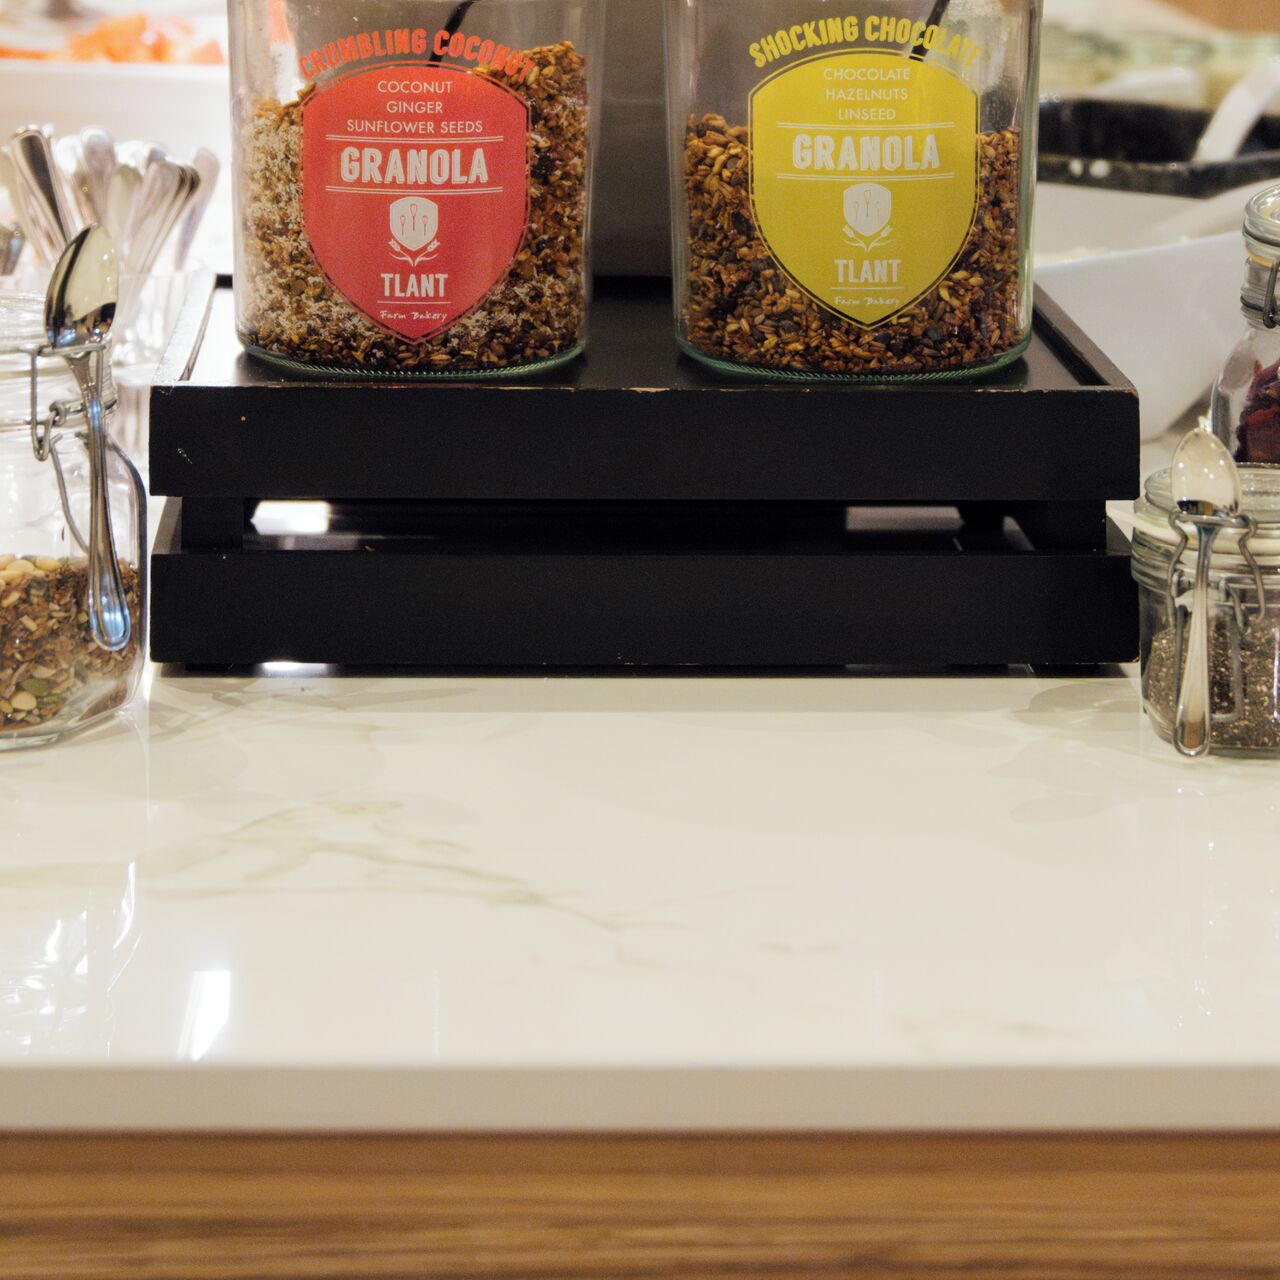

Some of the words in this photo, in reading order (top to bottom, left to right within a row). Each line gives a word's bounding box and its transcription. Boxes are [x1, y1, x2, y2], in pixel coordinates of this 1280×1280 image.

[748, 14, 859, 68] SHOCKING
[298, 28, 427, 81] CRUMBLING
[433, 29, 537, 82] COCONUT
[823, 67, 911, 81] CHOCOLATE
[377, 80, 453, 94] COCONUT
[825, 87, 908, 102] HAZELNUTS
[386, 101, 444, 114] GINGER
[838, 107, 896, 120] LINSEED
[346, 119, 436, 134] SUNFLOWER
[440, 120, 483, 133] SEEDS
[792, 133, 941, 170] GRANOLA
[340, 146, 489, 185] GRANOLA
[834, 259, 902, 284] TLANT
[380, 273, 449, 297] TLANT
[379, 310, 406, 319] Farm
